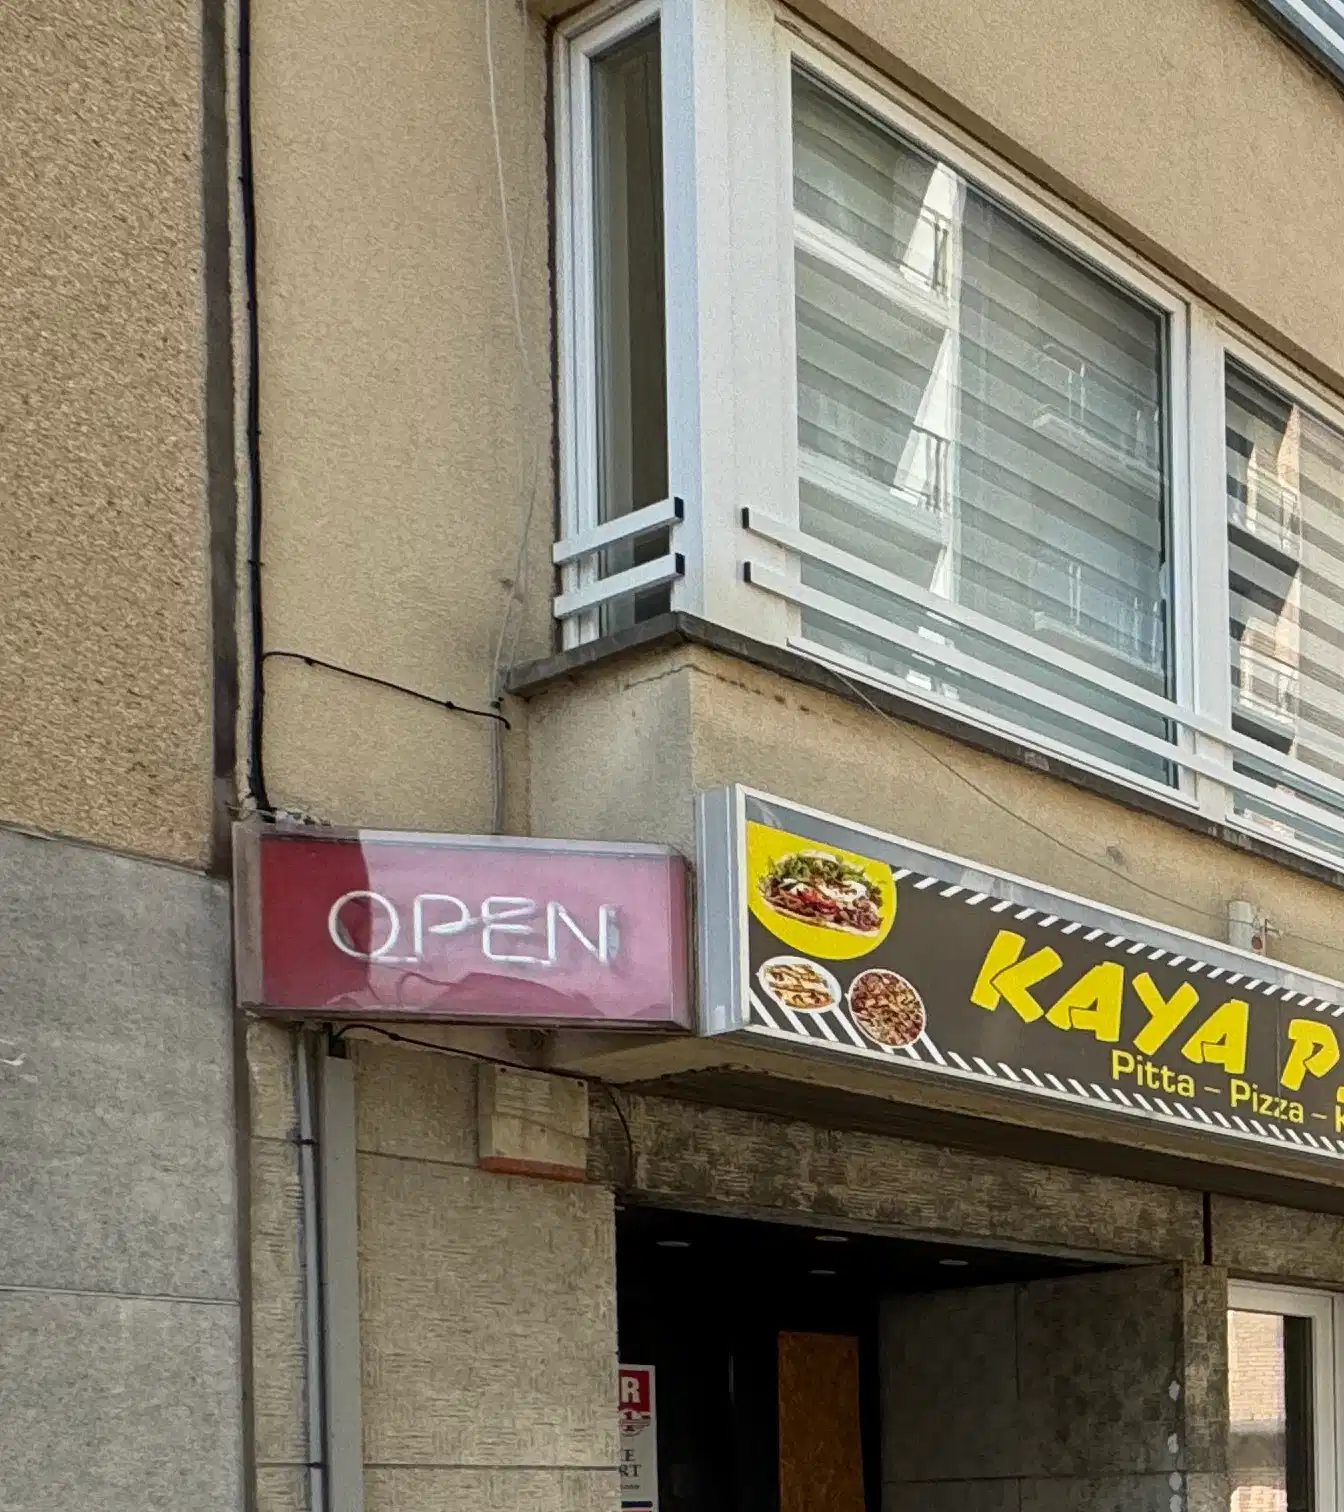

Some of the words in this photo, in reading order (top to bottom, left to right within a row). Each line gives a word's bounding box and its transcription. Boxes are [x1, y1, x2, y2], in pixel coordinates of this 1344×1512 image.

[328, 890, 611, 966] OPEN
[970, 929, 1249, 1074] KAYA
[1112, 1049, 1195, 1097] Pitta
[1230, 1079, 1304, 1124] Pizza
